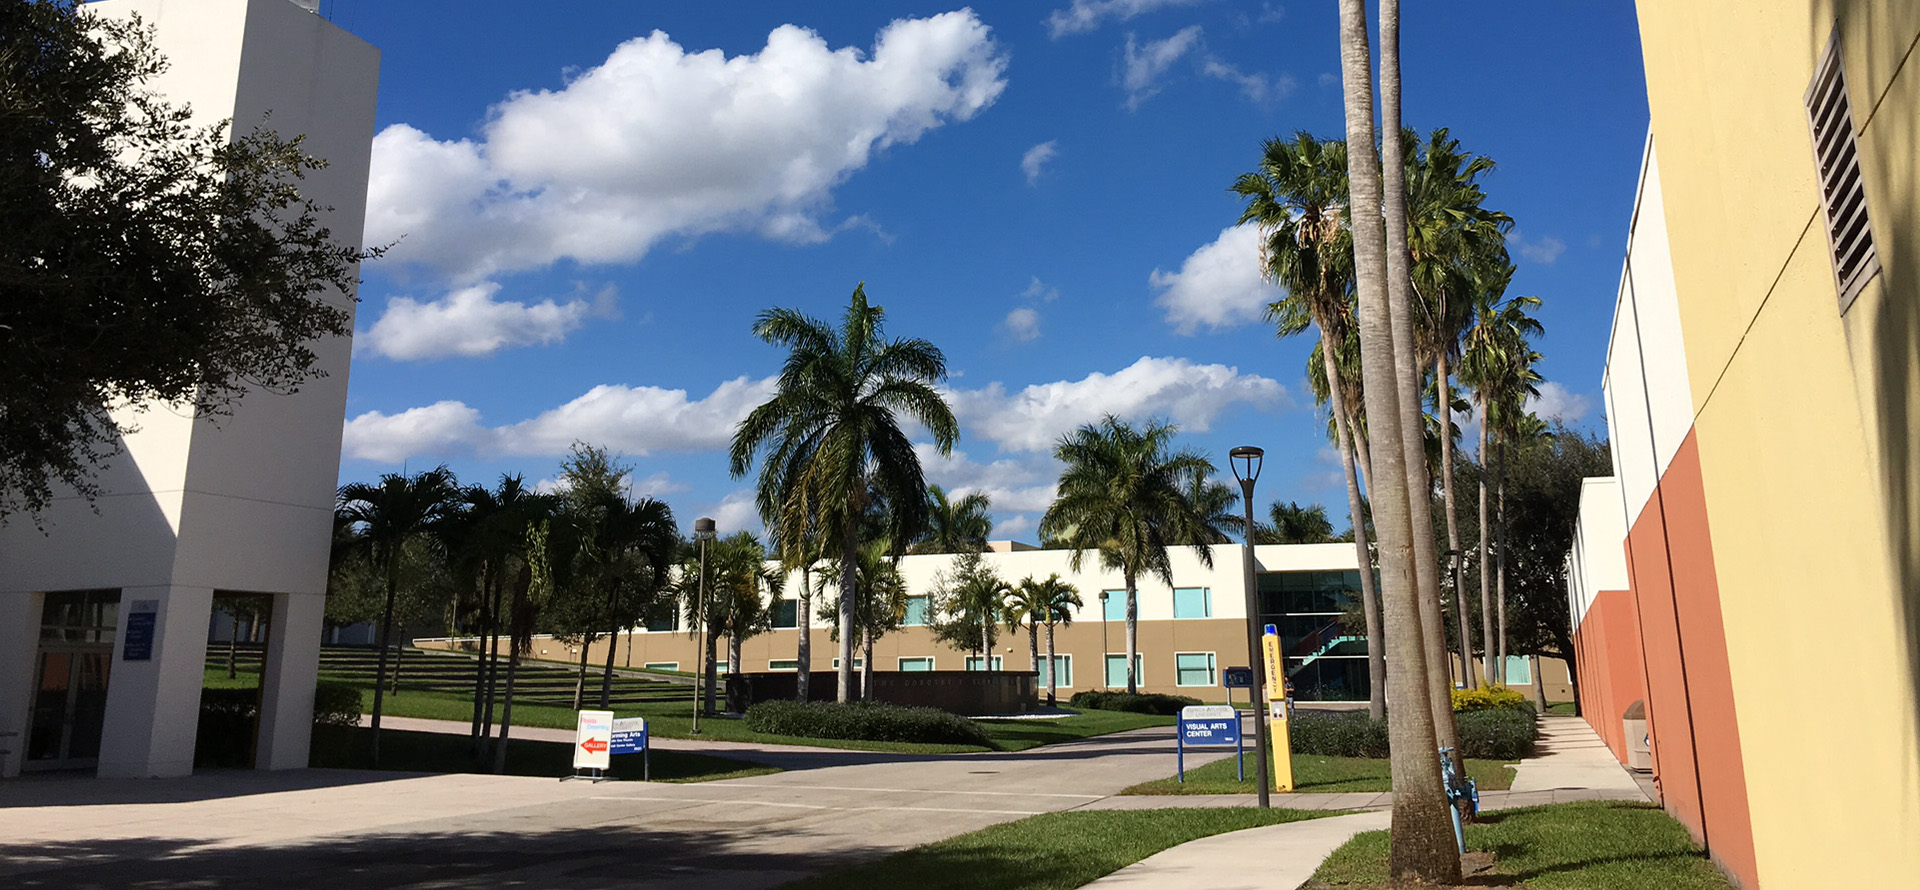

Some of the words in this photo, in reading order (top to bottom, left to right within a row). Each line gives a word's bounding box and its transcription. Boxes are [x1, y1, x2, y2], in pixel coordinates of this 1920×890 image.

[1268, 641, 1277, 693] EMERGENCY
[1210, 722, 1228, 730] ARTS
[1186, 730, 1213, 738] CENTER
